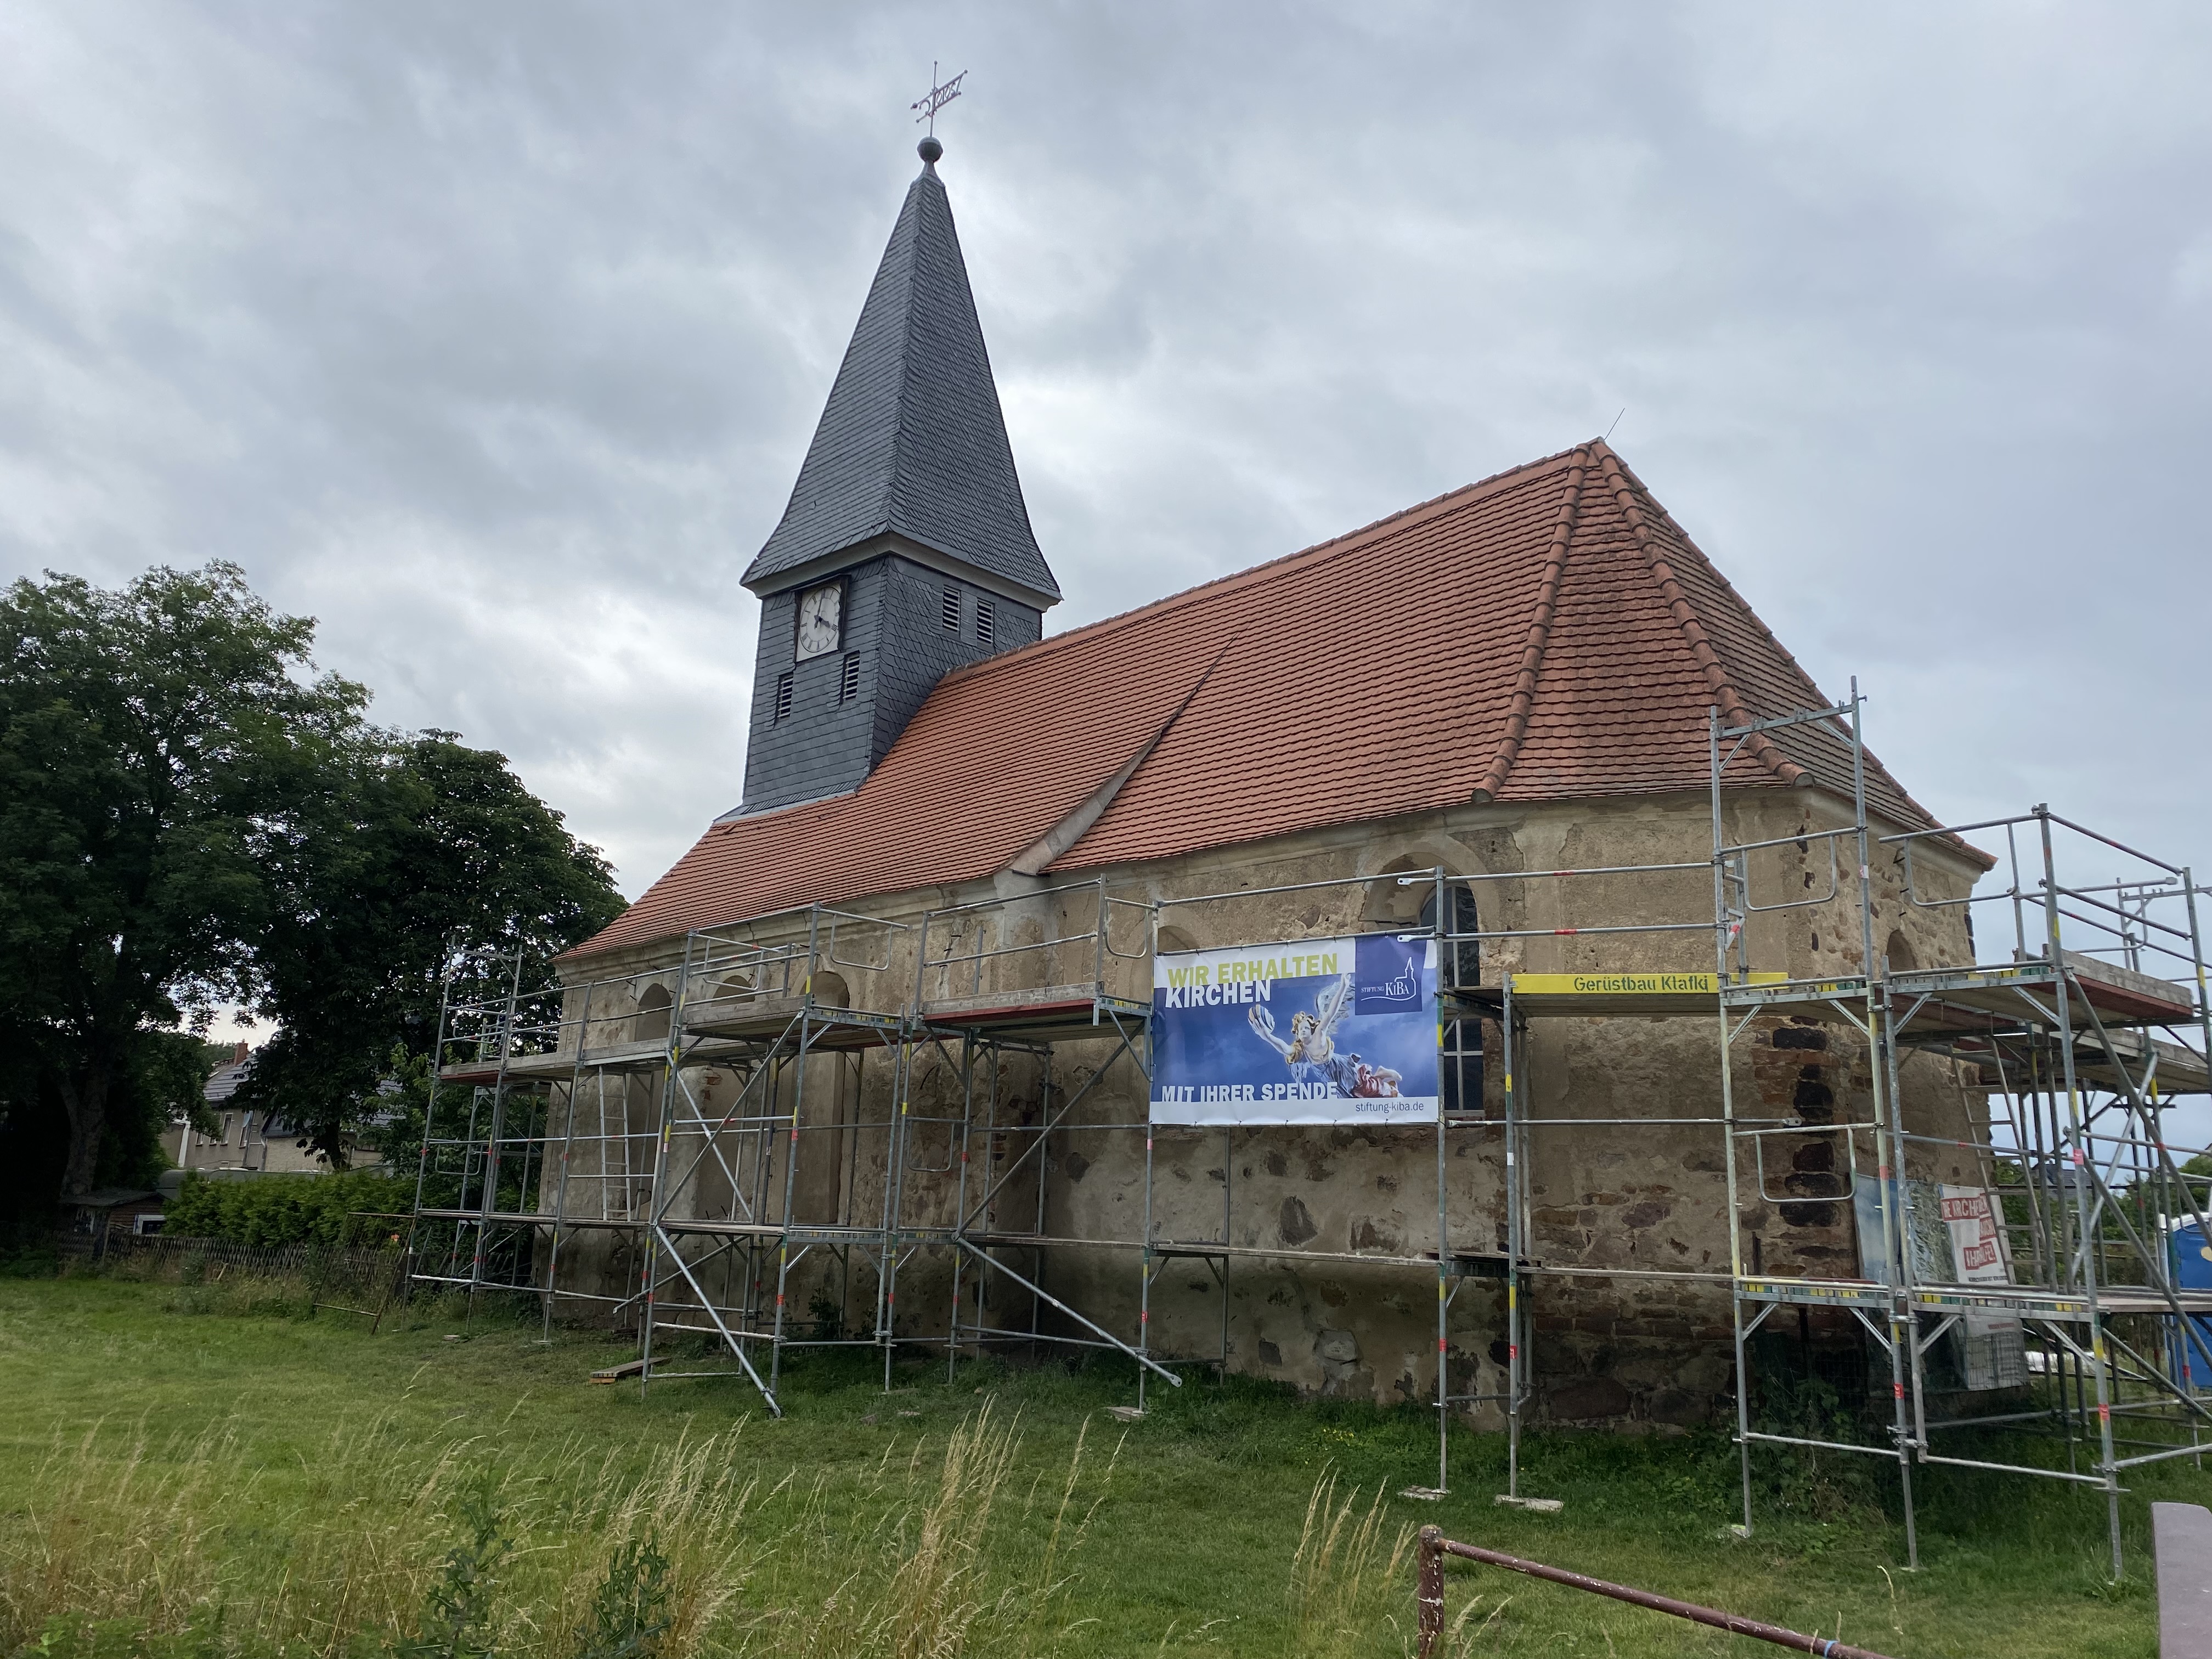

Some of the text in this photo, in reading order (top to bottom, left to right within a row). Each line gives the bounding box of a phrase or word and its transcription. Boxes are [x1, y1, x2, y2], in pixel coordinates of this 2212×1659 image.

[1167, 953, 1338, 988] WIR ERHALTEN
[1165, 979, 1271, 1008] KIRCHEN
[1574, 977, 1656, 991] Gerüstbau
[1161, 1082, 1338, 1102] MIT IHRER SPENDE
[1356, 1101, 1424, 1114] stiftung-kiba.de
